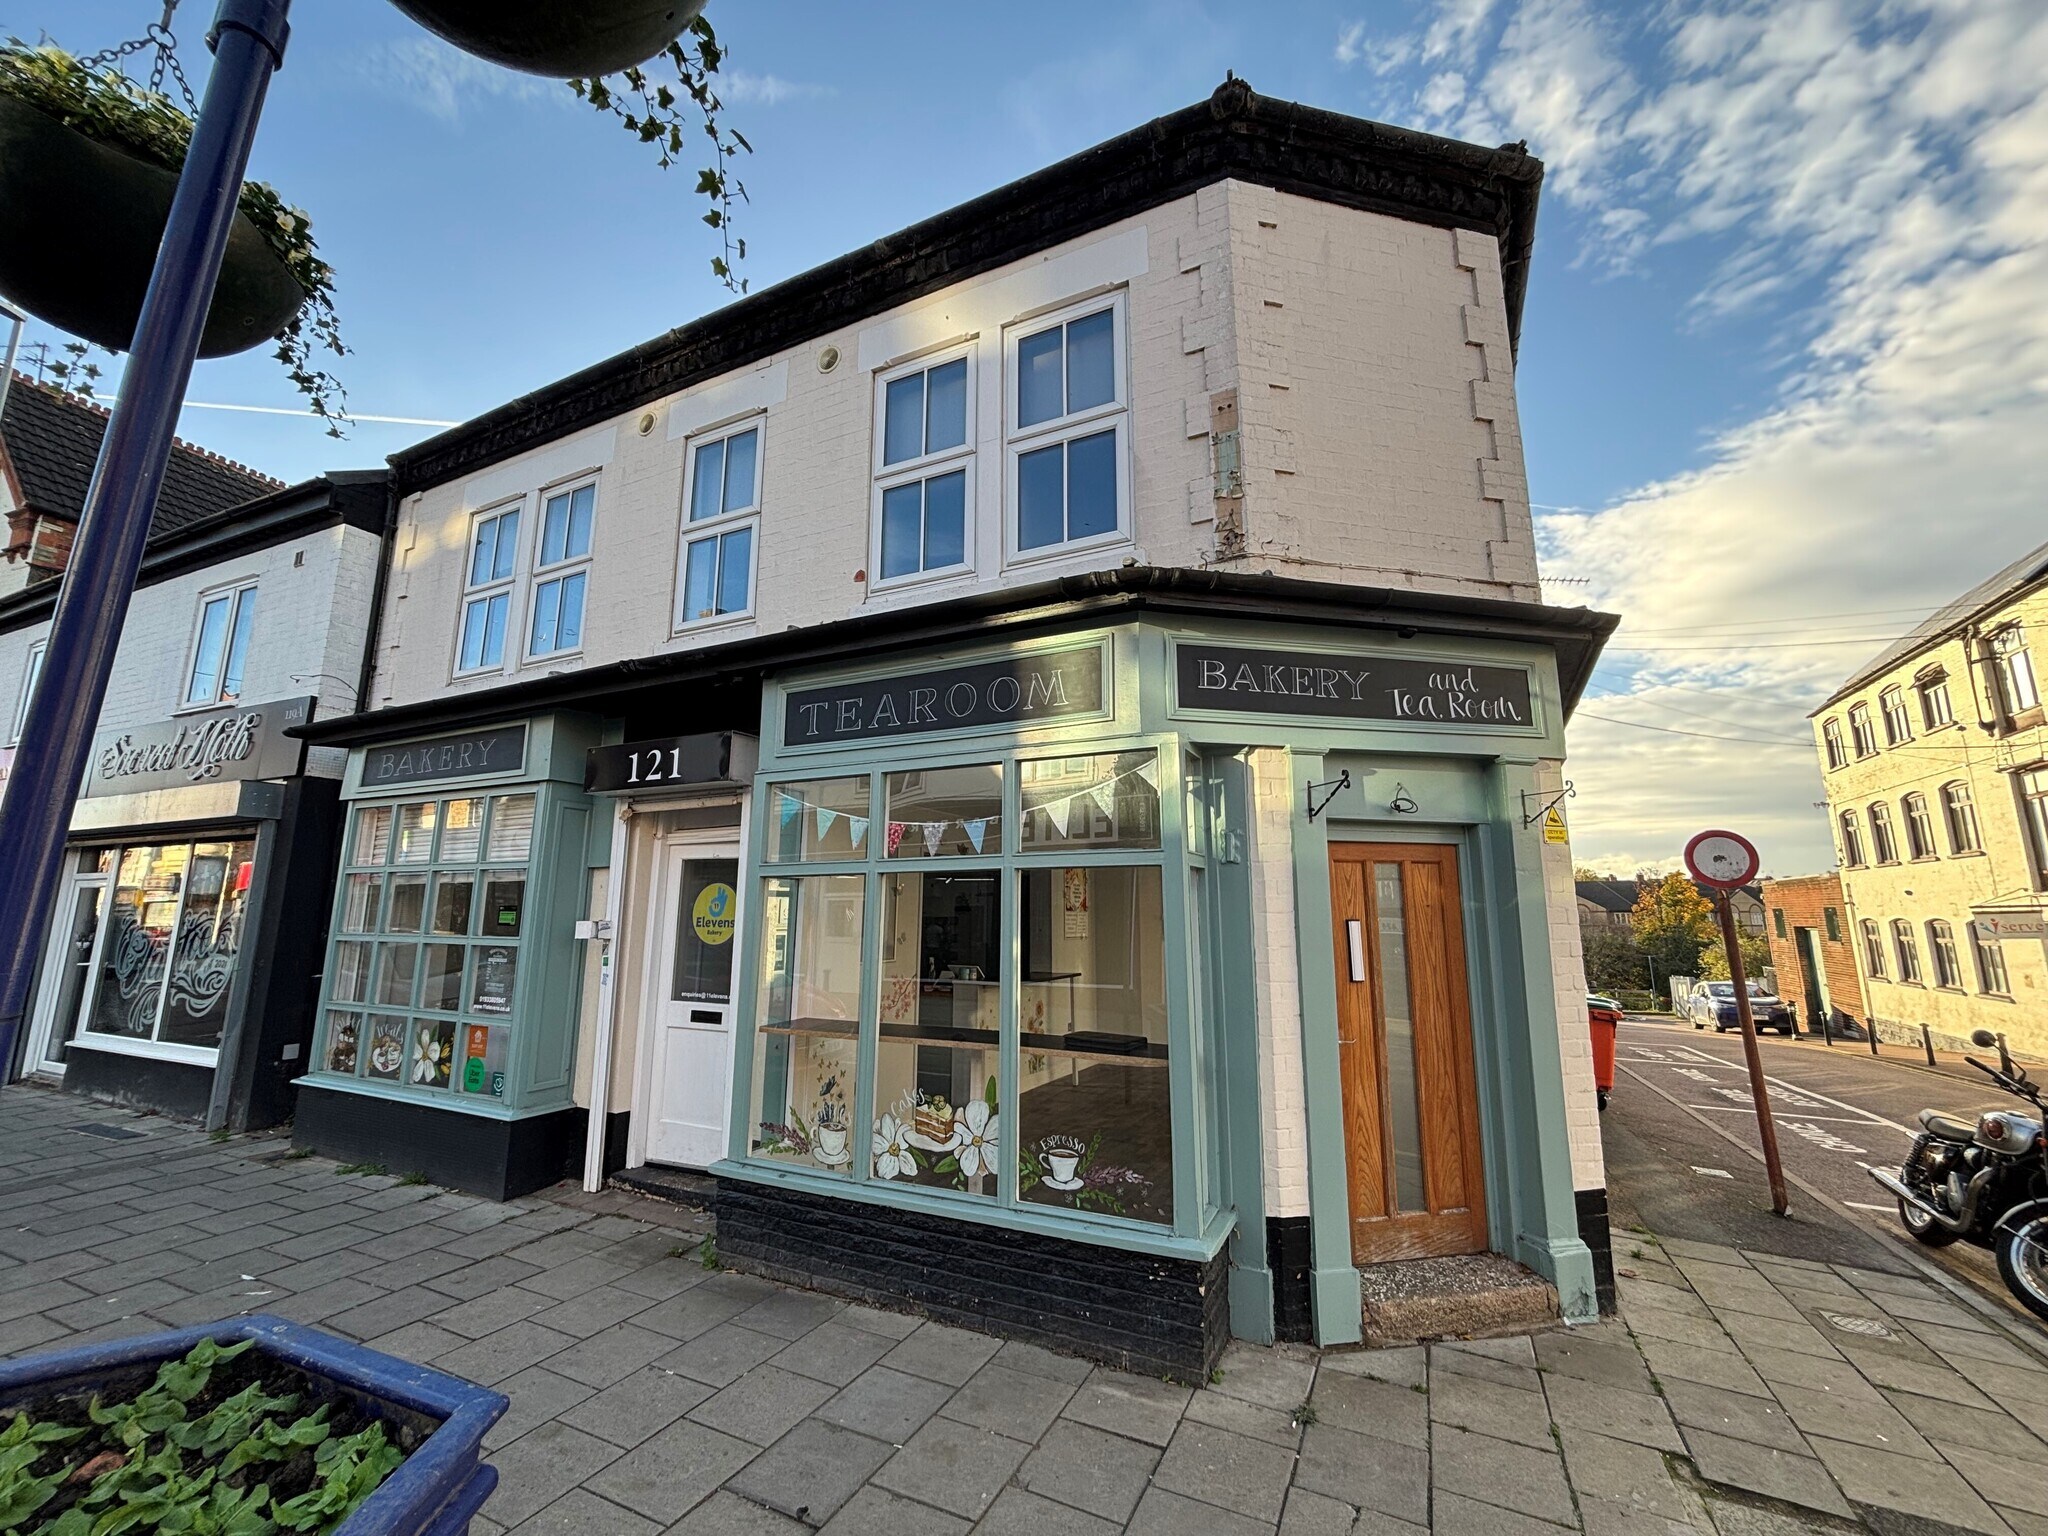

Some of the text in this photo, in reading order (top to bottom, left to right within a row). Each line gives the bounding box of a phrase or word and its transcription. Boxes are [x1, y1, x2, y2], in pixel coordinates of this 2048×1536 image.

[1197, 659, 1371, 700] BAKERY
[799, 669, 1070, 736] TEAROOM
[100, 713, 259, 781] Sacred Moth
[376, 738, 497, 779] BAKERY
[626, 747, 682, 783] 121
[695, 916, 735, 928] Elevens
[706, 929, 723, 937] Bakery
[2000, 922, 2045, 932] serve
[1039, 1134, 1086, 1155] Espresso
